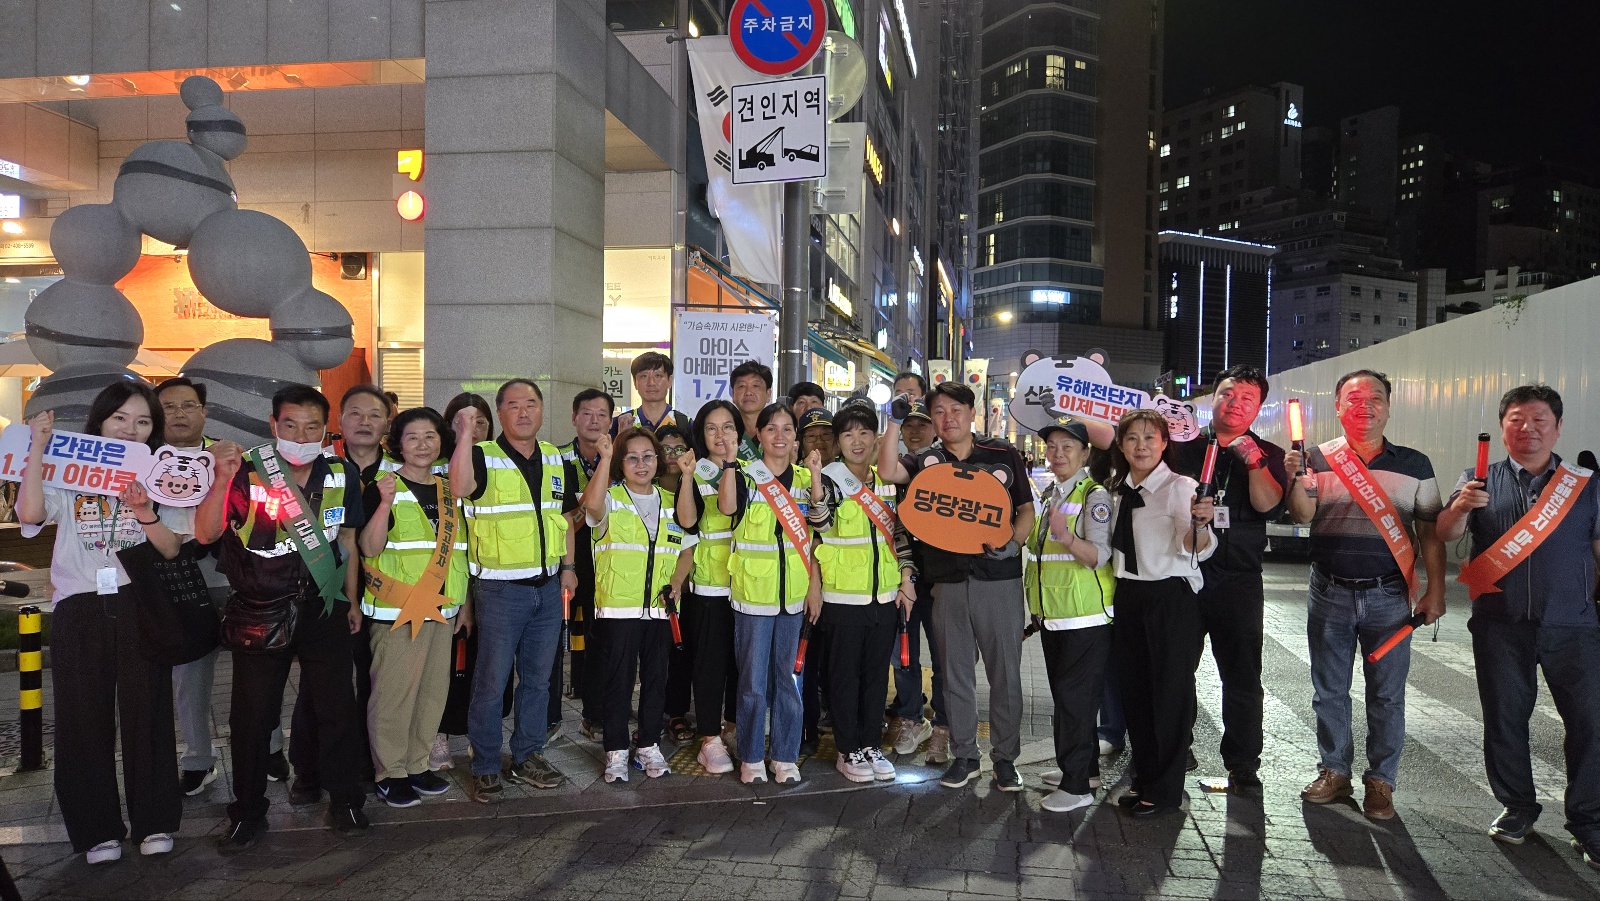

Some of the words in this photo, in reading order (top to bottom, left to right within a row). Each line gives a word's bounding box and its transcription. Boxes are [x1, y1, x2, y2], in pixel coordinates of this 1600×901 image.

[743, 14, 812, 33] 주차금지
[738, 88, 820, 122] 견인지역
[699, 337, 750, 357] 아이스
[1056, 375, 1142, 409] 유해전단지
[62, 463, 137, 492] 이하로
[1334, 450, 1386, 513] 유해전단지
[913, 488, 1003, 528] 당당광고
[1529, 474, 1578, 532] 유해전단지
[1500, 528, 1535, 560] 아웃
